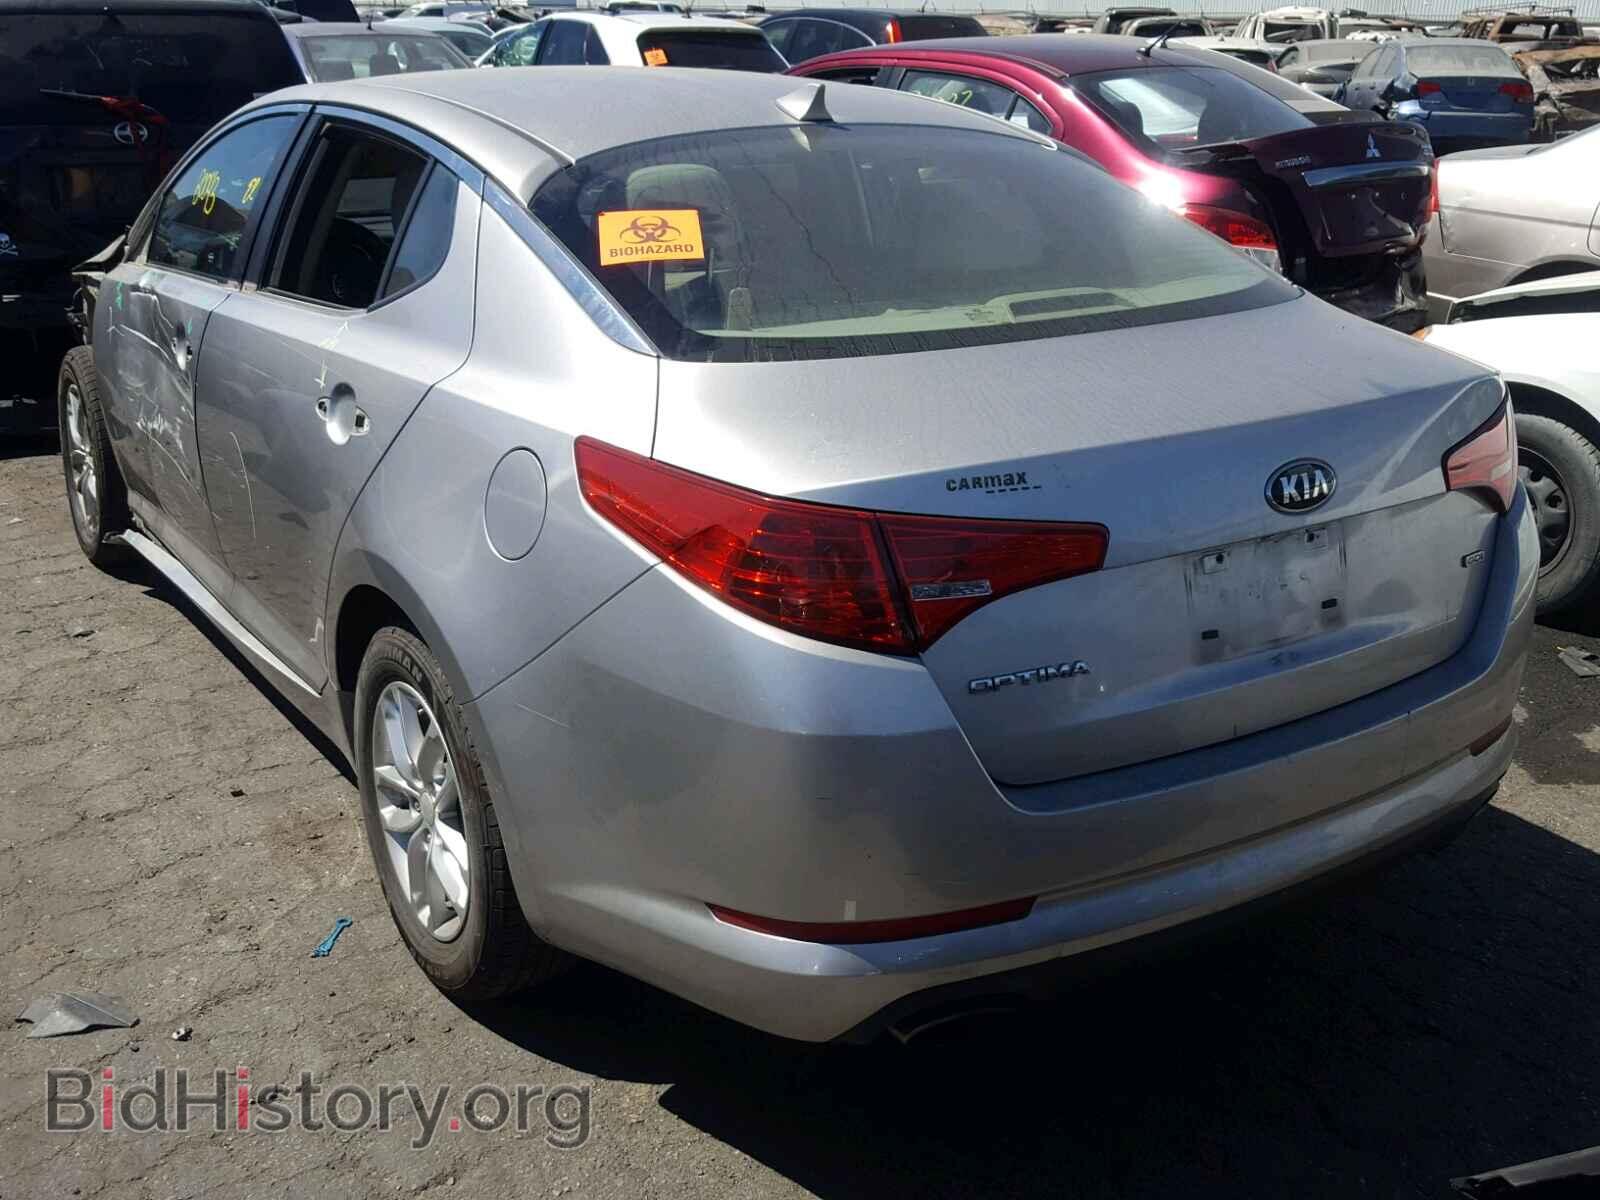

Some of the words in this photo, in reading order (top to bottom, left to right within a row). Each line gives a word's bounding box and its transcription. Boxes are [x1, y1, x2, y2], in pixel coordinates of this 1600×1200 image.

[609, 243, 694, 258] BIOHAZARD
[1280, 469, 1329, 504] KIA
[968, 660, 1089, 694] OPTIMA
